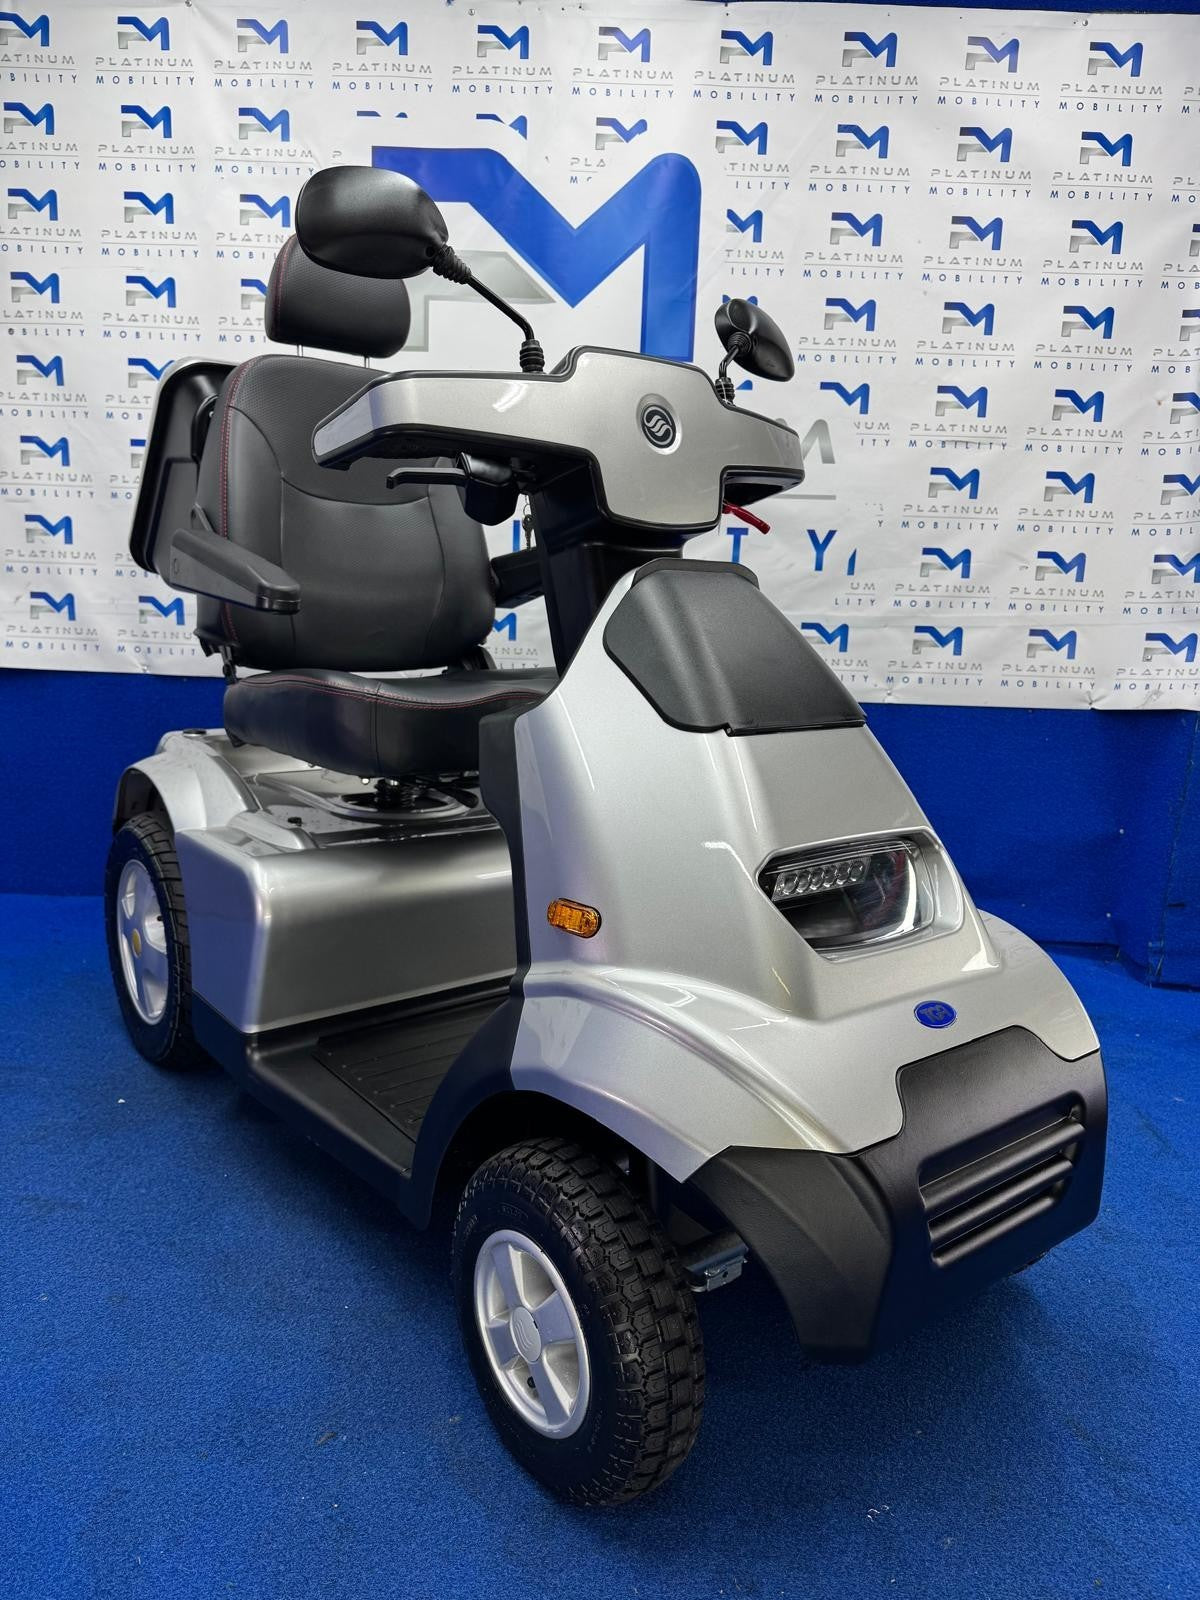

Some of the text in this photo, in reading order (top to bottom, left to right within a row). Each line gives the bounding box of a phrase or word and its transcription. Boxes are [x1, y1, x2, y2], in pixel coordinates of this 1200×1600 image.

[0, 54, 74, 64] ATINUM
[96, 57, 193, 67] PLATINUM
[214, 60, 312, 70] PLATINUM
[332, 63, 432, 73] PLATINUM
[452, 66, 552, 75] PLATINUM
[573, 68, 673, 79] PLATINUM
[0, 73, 77, 83] BILITY
[96, 76, 194, 85] MOBILITY
[695, 71, 794, 83] PLATINUM
[816, 75, 918, 86] PLATINUM
[215, 79, 313, 88] MOBILITY
[332, 81, 432, 92] MOBILITY
[940, 77, 1040, 90] PLATINUM
[452, 85, 552, 94] MOBILITY
[572, 87, 673, 98] MOBILITY
[1061, 84, 1162, 94] PLATINUM
[693, 90, 795, 101] MOBILITY
[815, 94, 917, 104] MOBILITY
[938, 96, 1039, 108] MOBILITY
[1059, 102, 1162, 112] MOBILITY
[0, 142, 78, 151] ATINUM
[98, 144, 194, 154] PLATINUM
[215, 147, 312, 157] PLATINUM
[0, 160, 79, 169] OBILITY
[99, 163, 195, 172] MOBILITY
[729, 163, 789, 172] TINUM
[215, 165, 313, 175] MOBILITY
[810, 165, 910, 176] PLATINUM
[931, 169, 1031, 179] PLATINUM
[1053, 172, 1152, 183] PLATINUM
[736, 181, 789, 190] ILITY
[809, 183, 910, 194] MOBILITY
[929, 187, 1031, 197] MOBILITY
[1050, 190, 1152, 201] MOBILITY
[0, 225, 81, 237] LATINUM
[101, 230, 197, 240] PLATINUM
[216, 232, 284, 243] PLATIN
[1, 244, 83, 254] OBILITY
[102, 248, 198, 257] MOBILITY
[725, 249, 784, 259] TINUM
[804, 252, 903, 263] PLATINUM
[923, 256, 1022, 267] PLATINUM
[1043, 260, 1143, 270] PLATINUM
[731, 267, 784, 276] ILITY
[803, 269, 903, 280] MOBILITY
[922, 273, 1022, 284] MOBILITY
[1041, 277, 1142, 287] MOBILITY
[3, 310, 83, 319] LATINUM
[103, 313, 199, 324] PLATINUM
[219, 317, 262, 326] PLAT
[8, 328, 84, 336] OBILITY
[103, 330, 200, 341] MOBILITY
[218, 334, 266, 343] MOBI
[799, 337, 896, 347] PLATINUM
[917, 341, 1014, 351] PLATINUM
[1035, 344, 1132, 355] PLATINUM
[1153, 347, 1200, 357] PLAT
[798, 354, 896, 364] MOBILITY
[915, 358, 1014, 367] MOBILITY
[1034, 361, 1132, 372] MOBILITY
[105, 395, 151, 404] PLAT
[910, 423, 1007, 434] PLATINUM
[1027, 427, 1123, 438] PLATINUM
[1143, 428, 1199, 440] PLATI
[909, 440, 1007, 450] MOBILITY
[1025, 444, 1122, 454] MOBILITY
[1141, 447, 1192, 456] MOBI
[1, 488, 93, 497] MOBILITY
[904, 504, 998, 515] PLATINUM
[1019, 508, 1113, 519] PLATINUM
[1133, 509, 1200, 520] PLATIN
[901, 521, 998, 530] MOBILITY
[1017, 524, 1113, 534] MOBILITY
[1131, 527, 1193, 536] MOBIL
[5, 549, 96, 559] PLATINUM
[6, 566, 97, 575] MOBILITY
[895, 584, 990, 593] PLATINUM
[1010, 587, 1104, 597] PLATINUM
[1125, 590, 1195, 599] PLATIN
[835, 598, 875, 606] LITY
[894, 600, 990, 608] MOBILITY
[1008, 603, 1104, 613] MOBILITY
[1123, 607, 1199, 615] MOBILI
[7, 625, 98, 636] PLATINUM
[118, 629, 192, 640] PLATINU
[6, 641, 99, 651] MOBILITY
[118, 645, 195, 656] MOBILIT
[888, 661, 982, 671] PLATINUM
[1002, 664, 1095, 674] PLATINUM
[1116, 668, 1200, 676] PLATINU
[886, 676, 982, 686] MOBILITY
[1001, 680, 1095, 689] MOBILITY
[1114, 682, 1199, 690] MOBILIT
